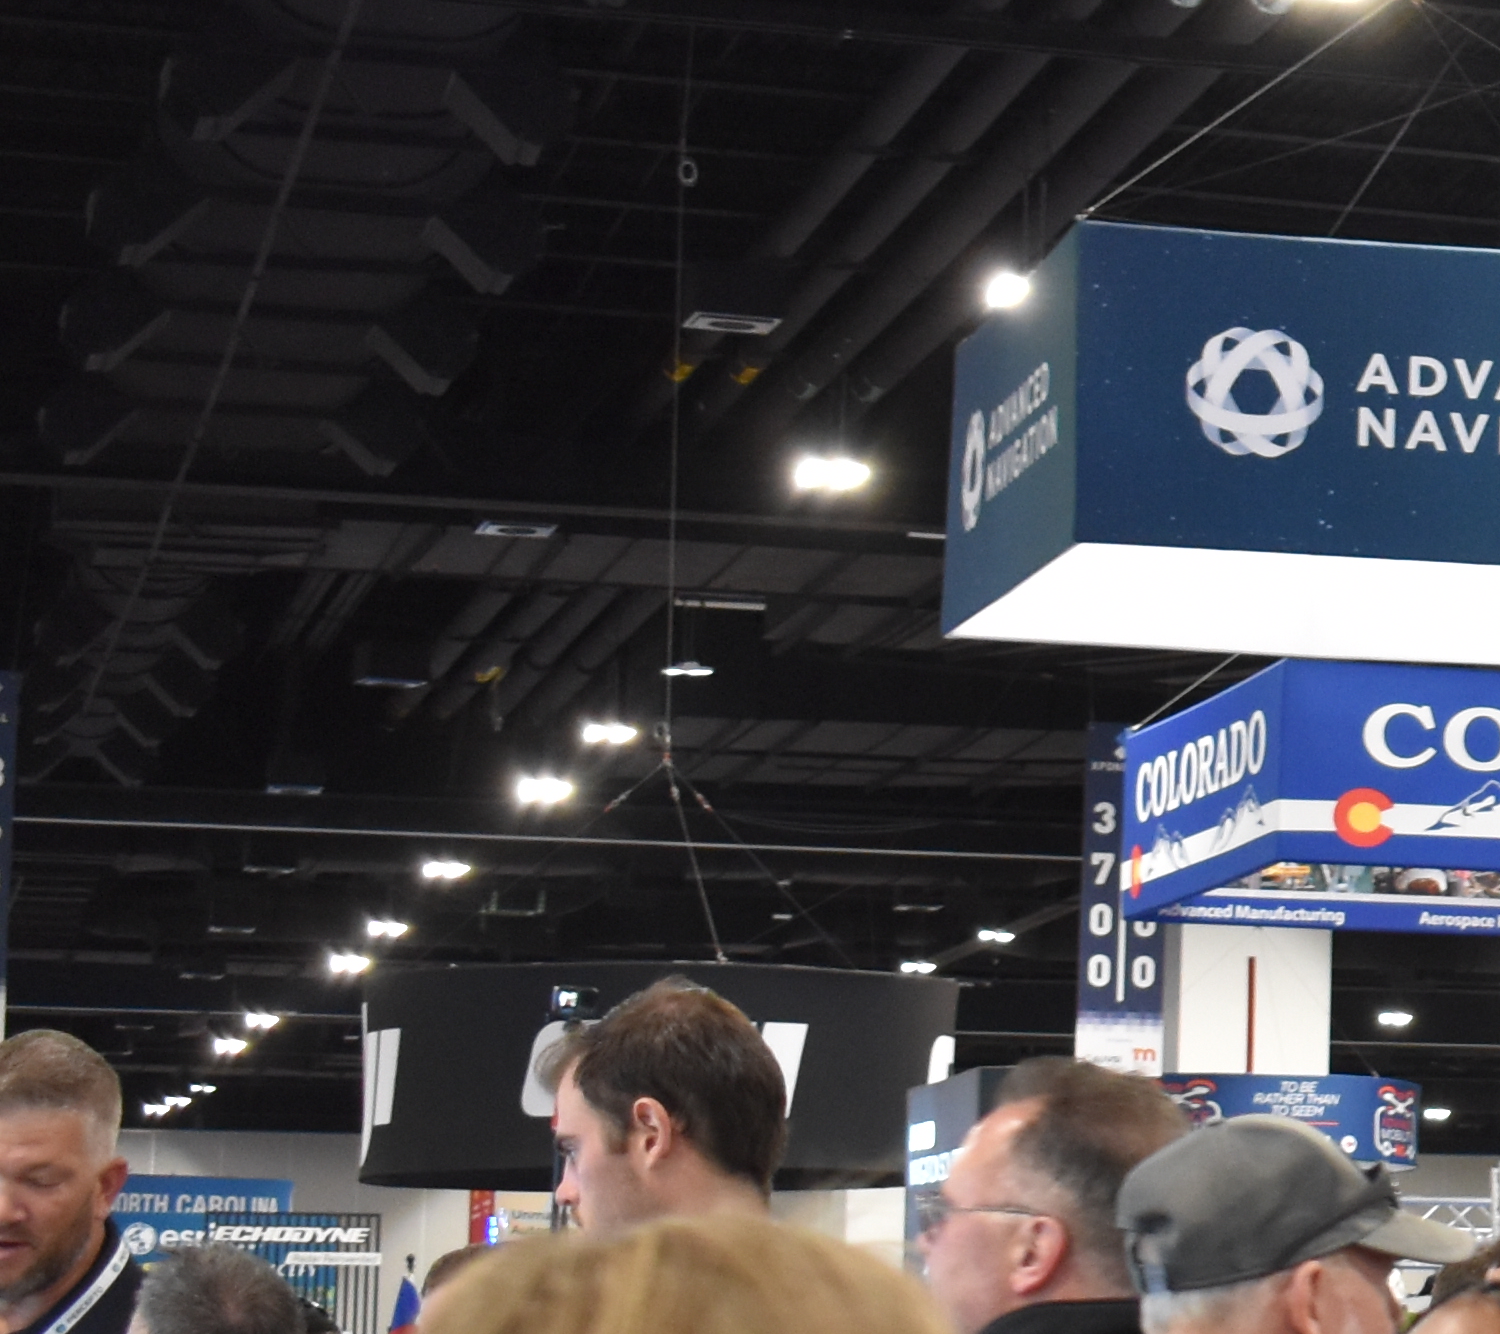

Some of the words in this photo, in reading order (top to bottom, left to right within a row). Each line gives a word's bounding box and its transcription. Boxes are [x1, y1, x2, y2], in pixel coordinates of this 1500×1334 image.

[1134, 709, 1267, 824] COLORADO
[1086, 801, 1118, 988] 3700
[1235, 905, 1346, 926] Manufacturing
[1418, 911, 1495, 931] Aerospace
[1280, 1080, 1299, 1093] TO
[1300, 1080, 1320, 1093] BE
[214, 1225, 371, 1244] ECHODYNE
